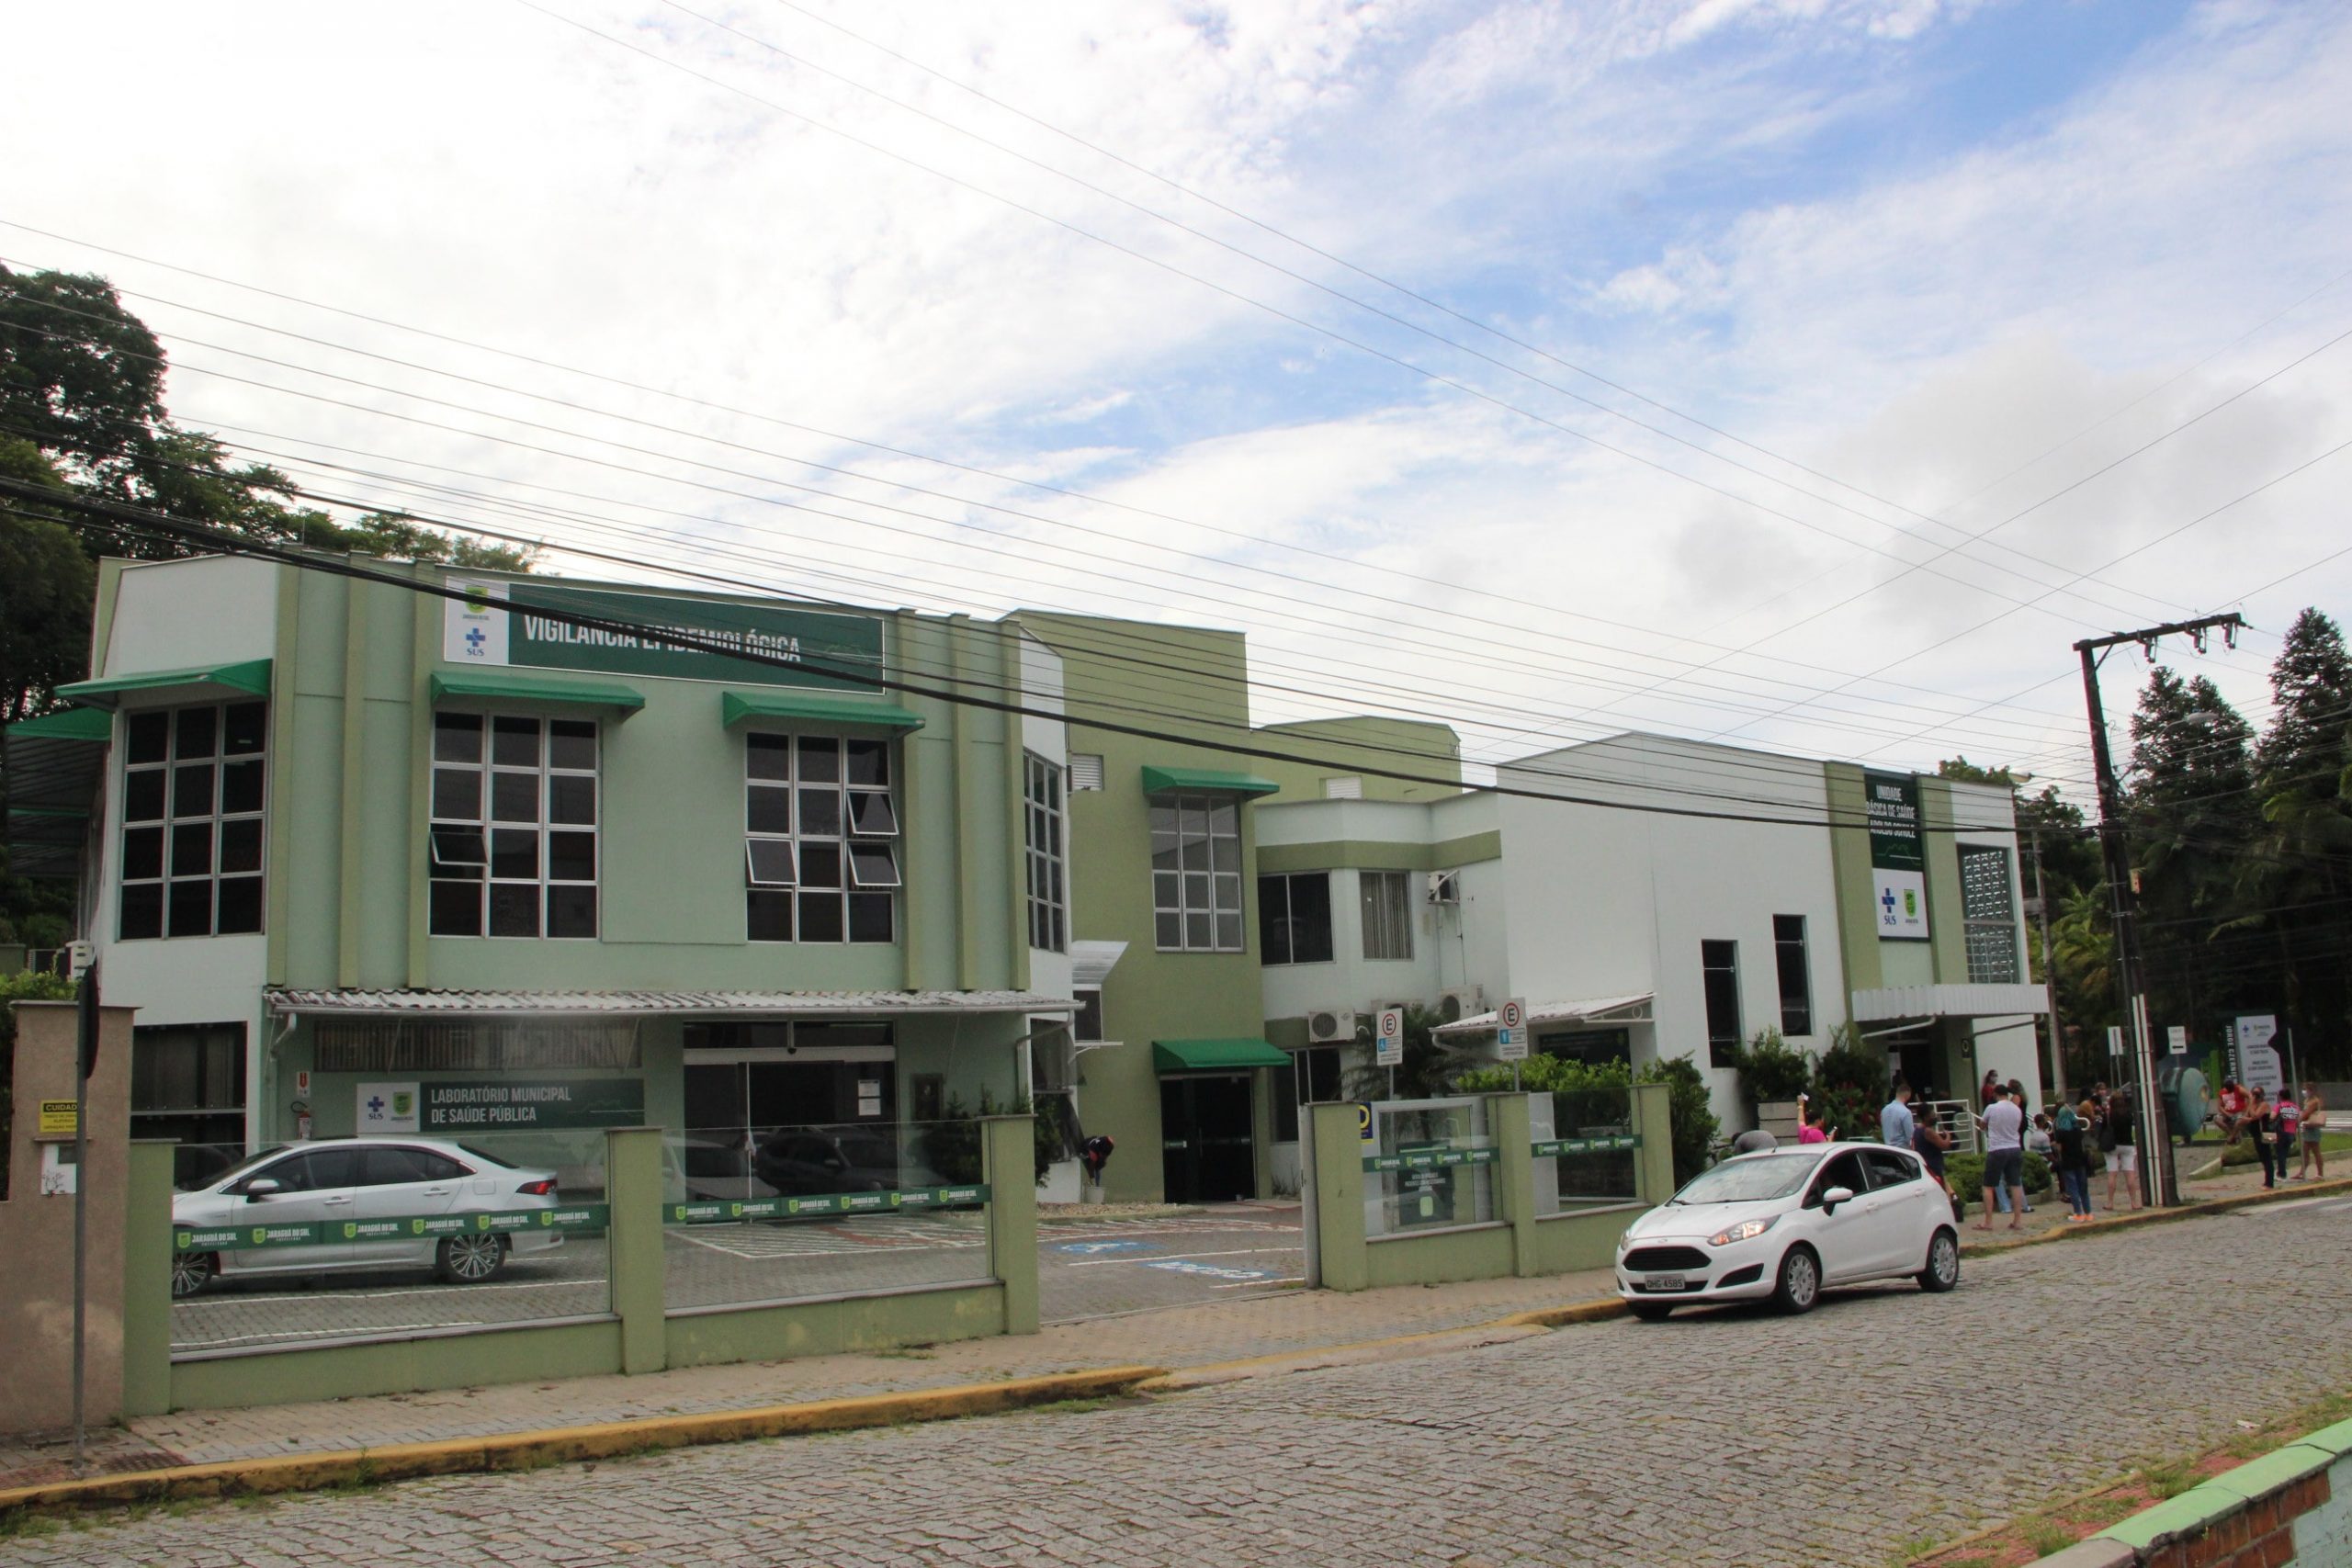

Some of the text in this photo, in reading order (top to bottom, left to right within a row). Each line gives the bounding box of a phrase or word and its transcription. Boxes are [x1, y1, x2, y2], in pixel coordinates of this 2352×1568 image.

[466, 648, 484, 657] SUS
[1888, 804, 1896, 818] DE
[1896, 803, 1915, 819] SAÚDE
[1883, 914, 1896, 926] SUS
[1508, 1008, 1515, 1022] E
[1386, 1018, 1393, 1032] E
[431, 1086, 572, 1104] LABORATÓRIO MUNICIPAL
[431, 1104, 537, 1123] DE SAÚDE PÚBLICA
